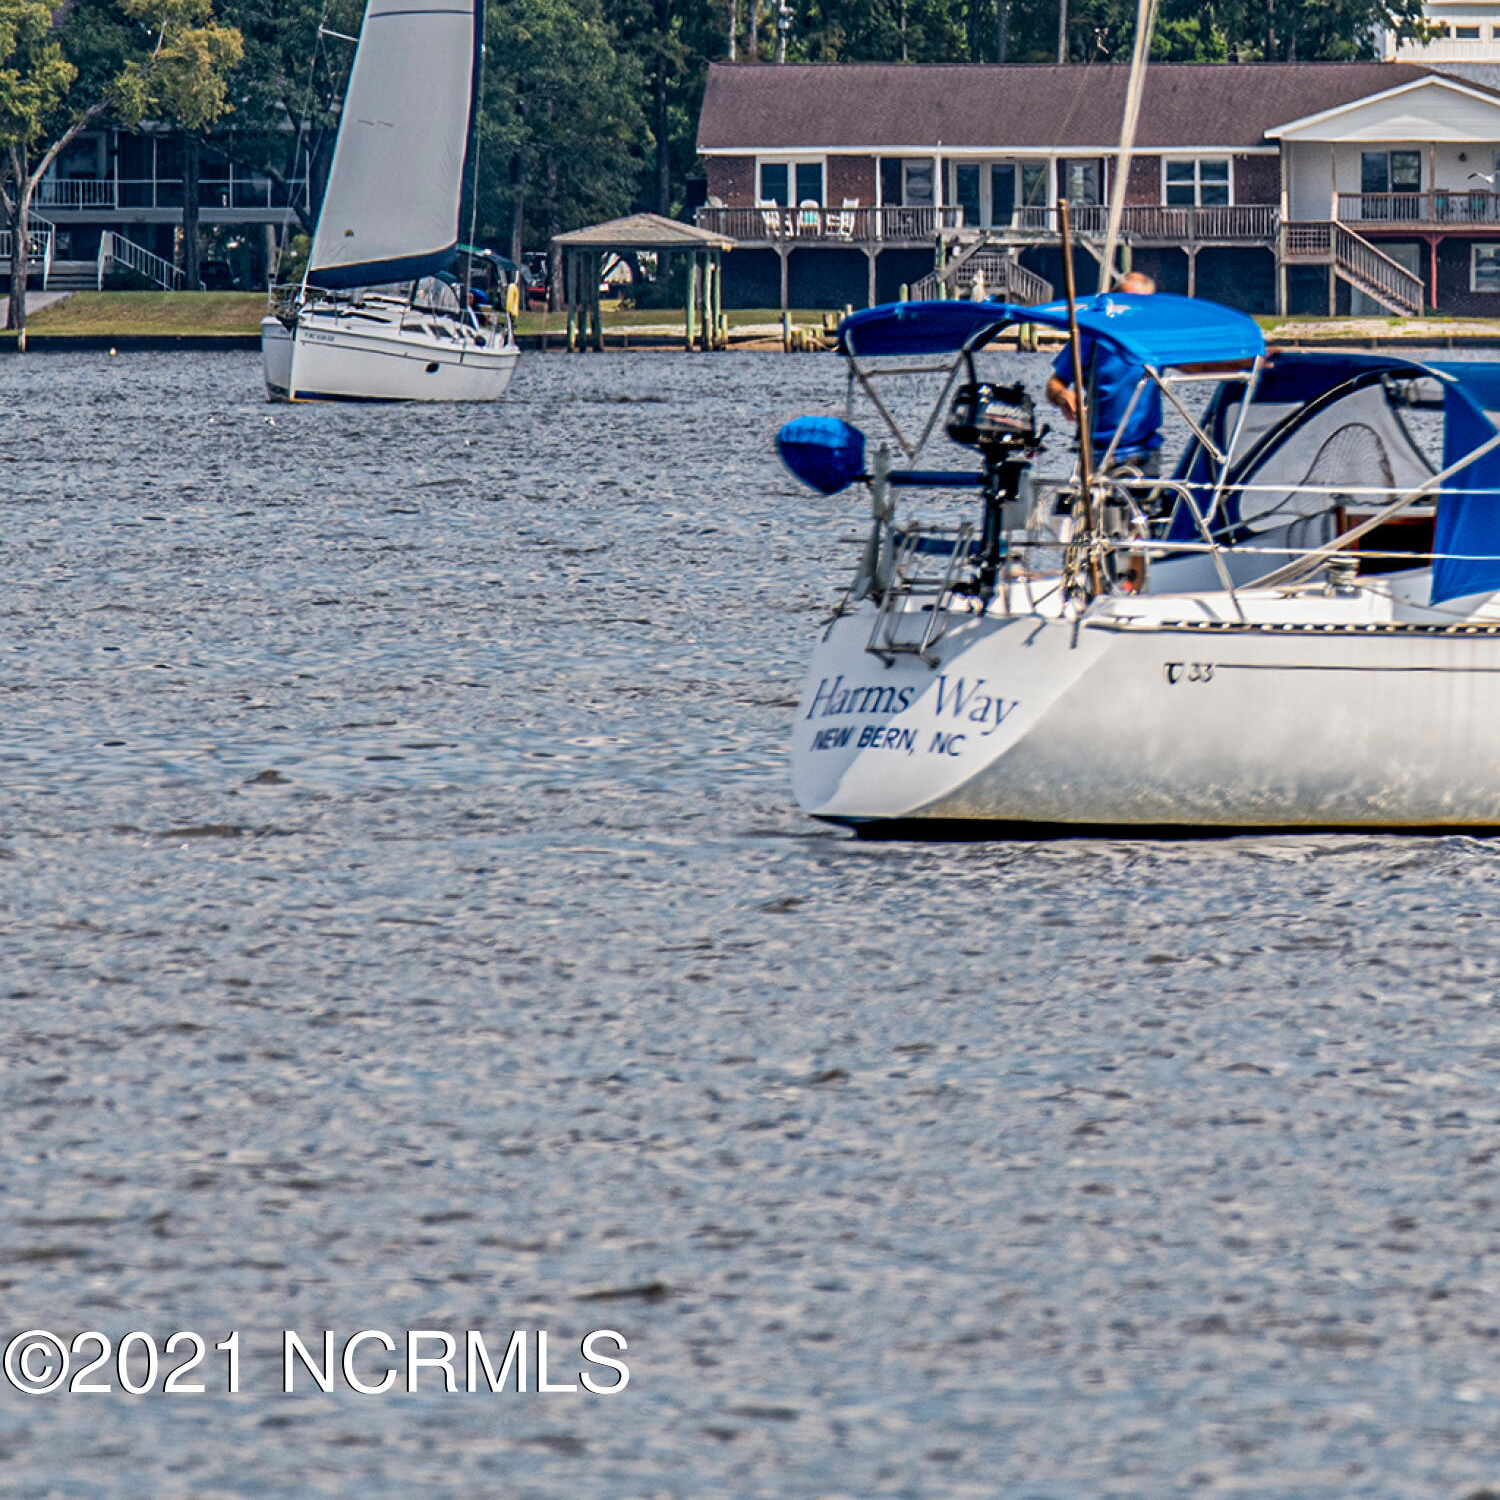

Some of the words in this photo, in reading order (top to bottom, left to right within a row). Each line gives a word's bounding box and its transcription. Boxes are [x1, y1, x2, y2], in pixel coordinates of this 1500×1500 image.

[805, 674, 915, 720] Harms
[936, 674, 1018, 736] Way
[810, 725, 855, 751] NEW
[857, 725, 917, 756] BERN,
[928, 731, 966, 756] NC
